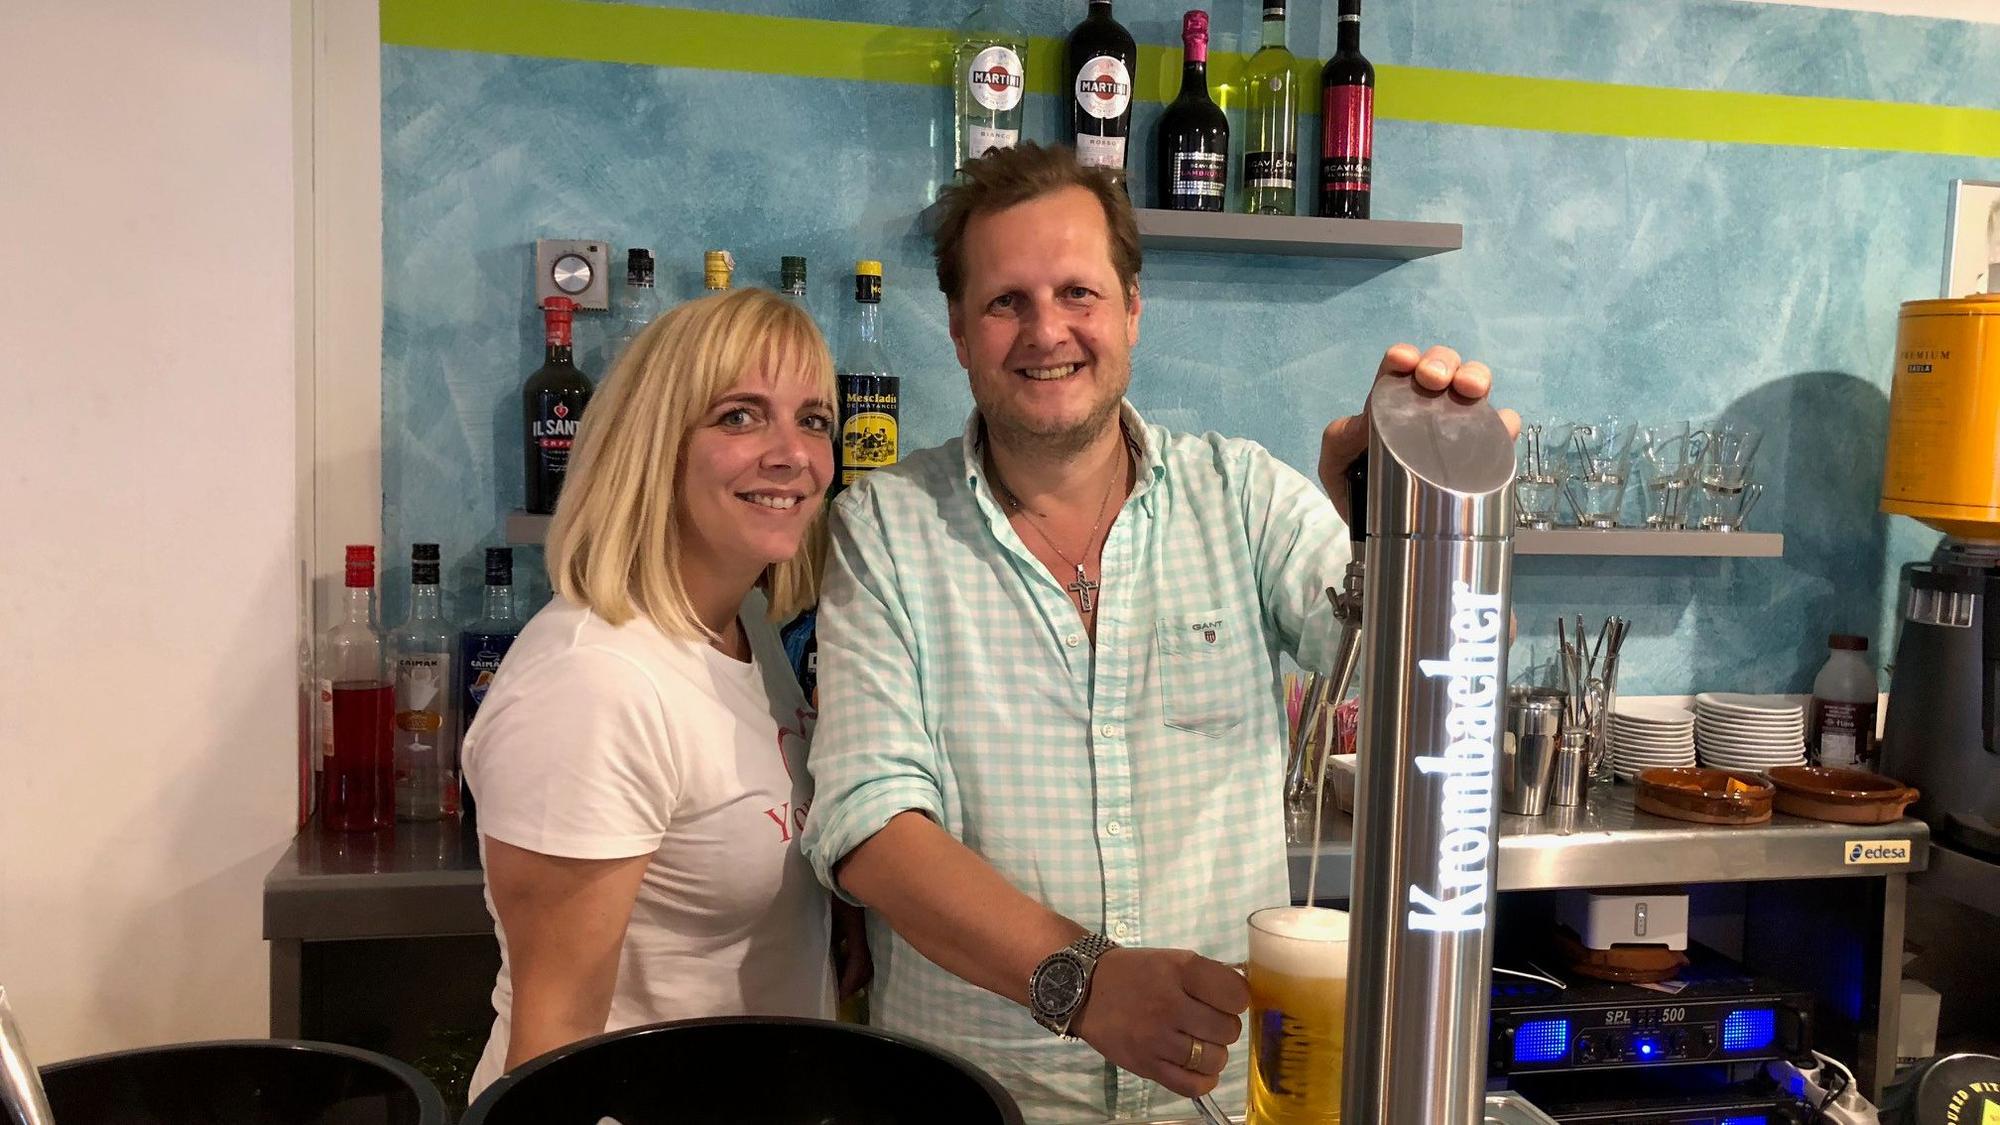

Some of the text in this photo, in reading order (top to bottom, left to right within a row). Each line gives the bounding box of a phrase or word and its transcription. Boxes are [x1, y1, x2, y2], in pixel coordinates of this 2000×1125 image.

[974, 72, 1020, 87] MARTINI
[1081, 81, 1127, 95] MARTINI
[980, 131, 1011, 139] BIANCO
[533, 419, 581, 437] IL SANT
[1192, 620, 1223, 631] GANT
[470, 660, 502, 668] CAIMA
[1408, 580, 1501, 930] Krombacher
[1865, 844, 1906, 859] edesa
[1605, 1008, 1686, 1022] SPL 500
[1969, 1082, 2000, 1093] WIT
